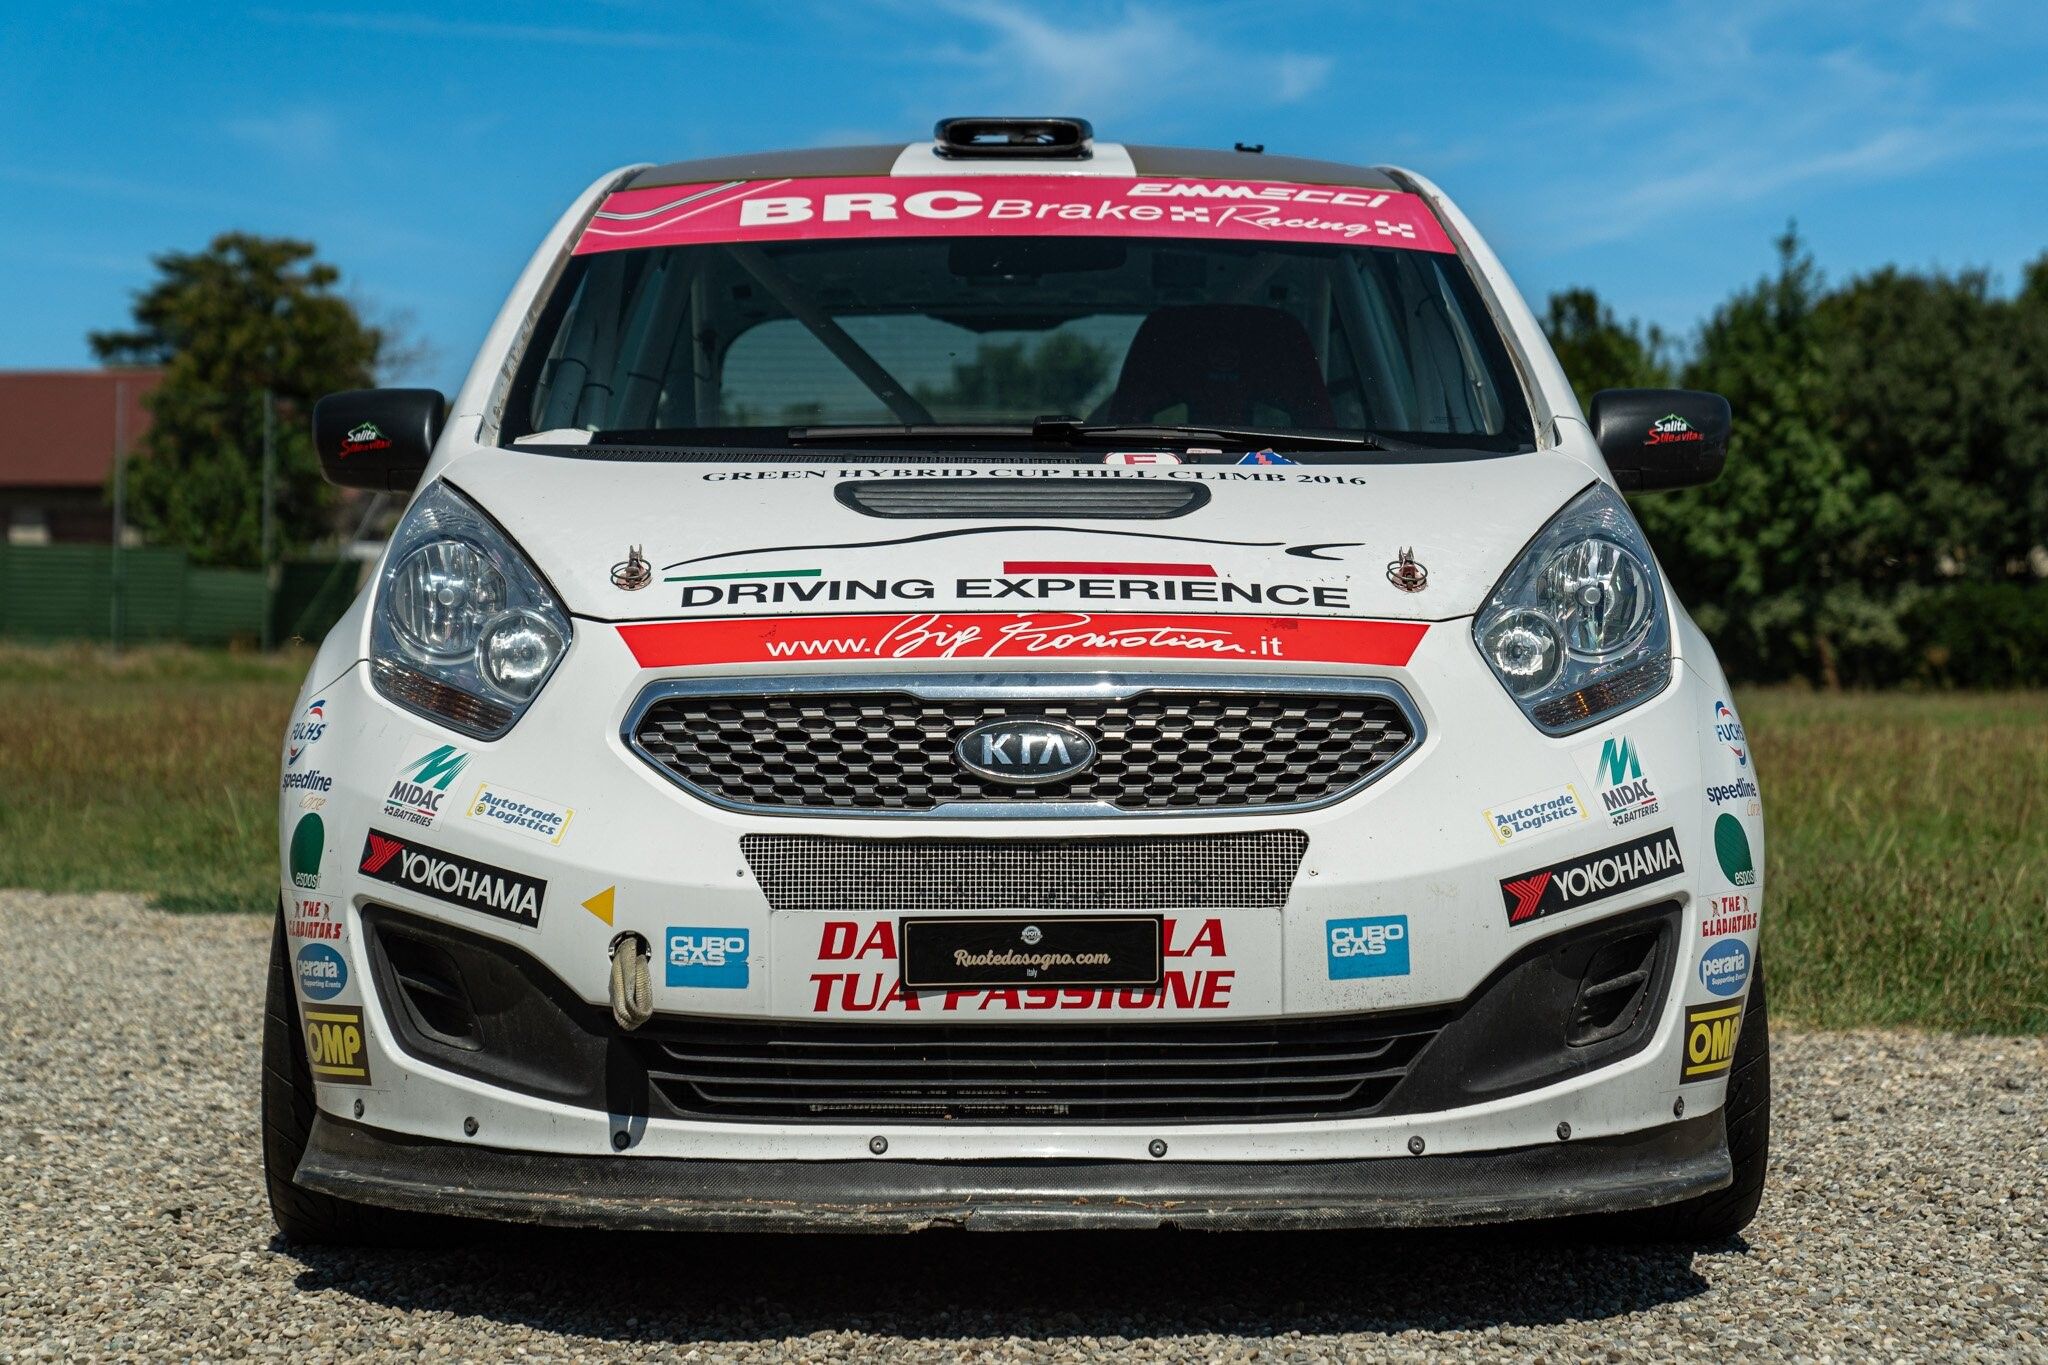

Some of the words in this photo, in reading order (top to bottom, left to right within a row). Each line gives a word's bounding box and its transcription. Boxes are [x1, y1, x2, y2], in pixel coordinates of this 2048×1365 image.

[1126, 183, 1390, 208] EMMECCI
[739, 190, 983, 226] BRC
[986, 199, 1163, 222] Brake
[1215, 204, 1371, 238] Racing
[347, 429, 377, 443] Salita
[1654, 420, 1687, 432] Salita
[702, 470, 829, 481] GREEN
[838, 469, 978, 478] HYBRID
[988, 468, 1060, 478] CUP
[1072, 470, 1157, 479] HILL
[1168, 471, 1287, 482] CLIMB
[1296, 474, 1367, 485] 2016
[680, 579, 936, 608] DRIVING
[956, 578, 1351, 609] EXPERIENCE
[290, 722, 326, 741] FUCHS
[1715, 723, 1745, 742] FUCHS
[981, 733, 1072, 765] KIA
[282, 769, 333, 793] speedline
[1706, 777, 1757, 806] speedline
[388, 779, 445, 812] MIDAC
[1601, 778, 1655, 811] MIDAC
[392, 808, 434, 827] BATTERIES
[479, 791, 563, 826] Autotrade
[487, 805, 556, 836] Logistics
[1494, 794, 1574, 827] Autotrade
[1511, 805, 1578, 833] Logistics
[1623, 802, 1660, 824] BATTERIES
[1551, 838, 1682, 901] YOKOHAMA
[400, 849, 538, 919] YOKOHAMA
[302, 900, 322, 918] THE
[1721, 895, 1741, 914] THE
[287, 920, 342, 939] GLADIATORS
[1331, 923, 1404, 943] CUBO
[1702, 912, 1758, 938] GLADIATORS
[670, 935, 745, 953] CUBO
[1331, 940, 1387, 957] GAS
[670, 950, 726, 967] GAS
[953, 948, 1112, 971] Ruotedasogno.com
[1703, 949, 1745, 989] peraria
[809, 973, 921, 1012] TUA
[307, 1022, 361, 1065] OMP
[1688, 1016, 1740, 1064] OMP
